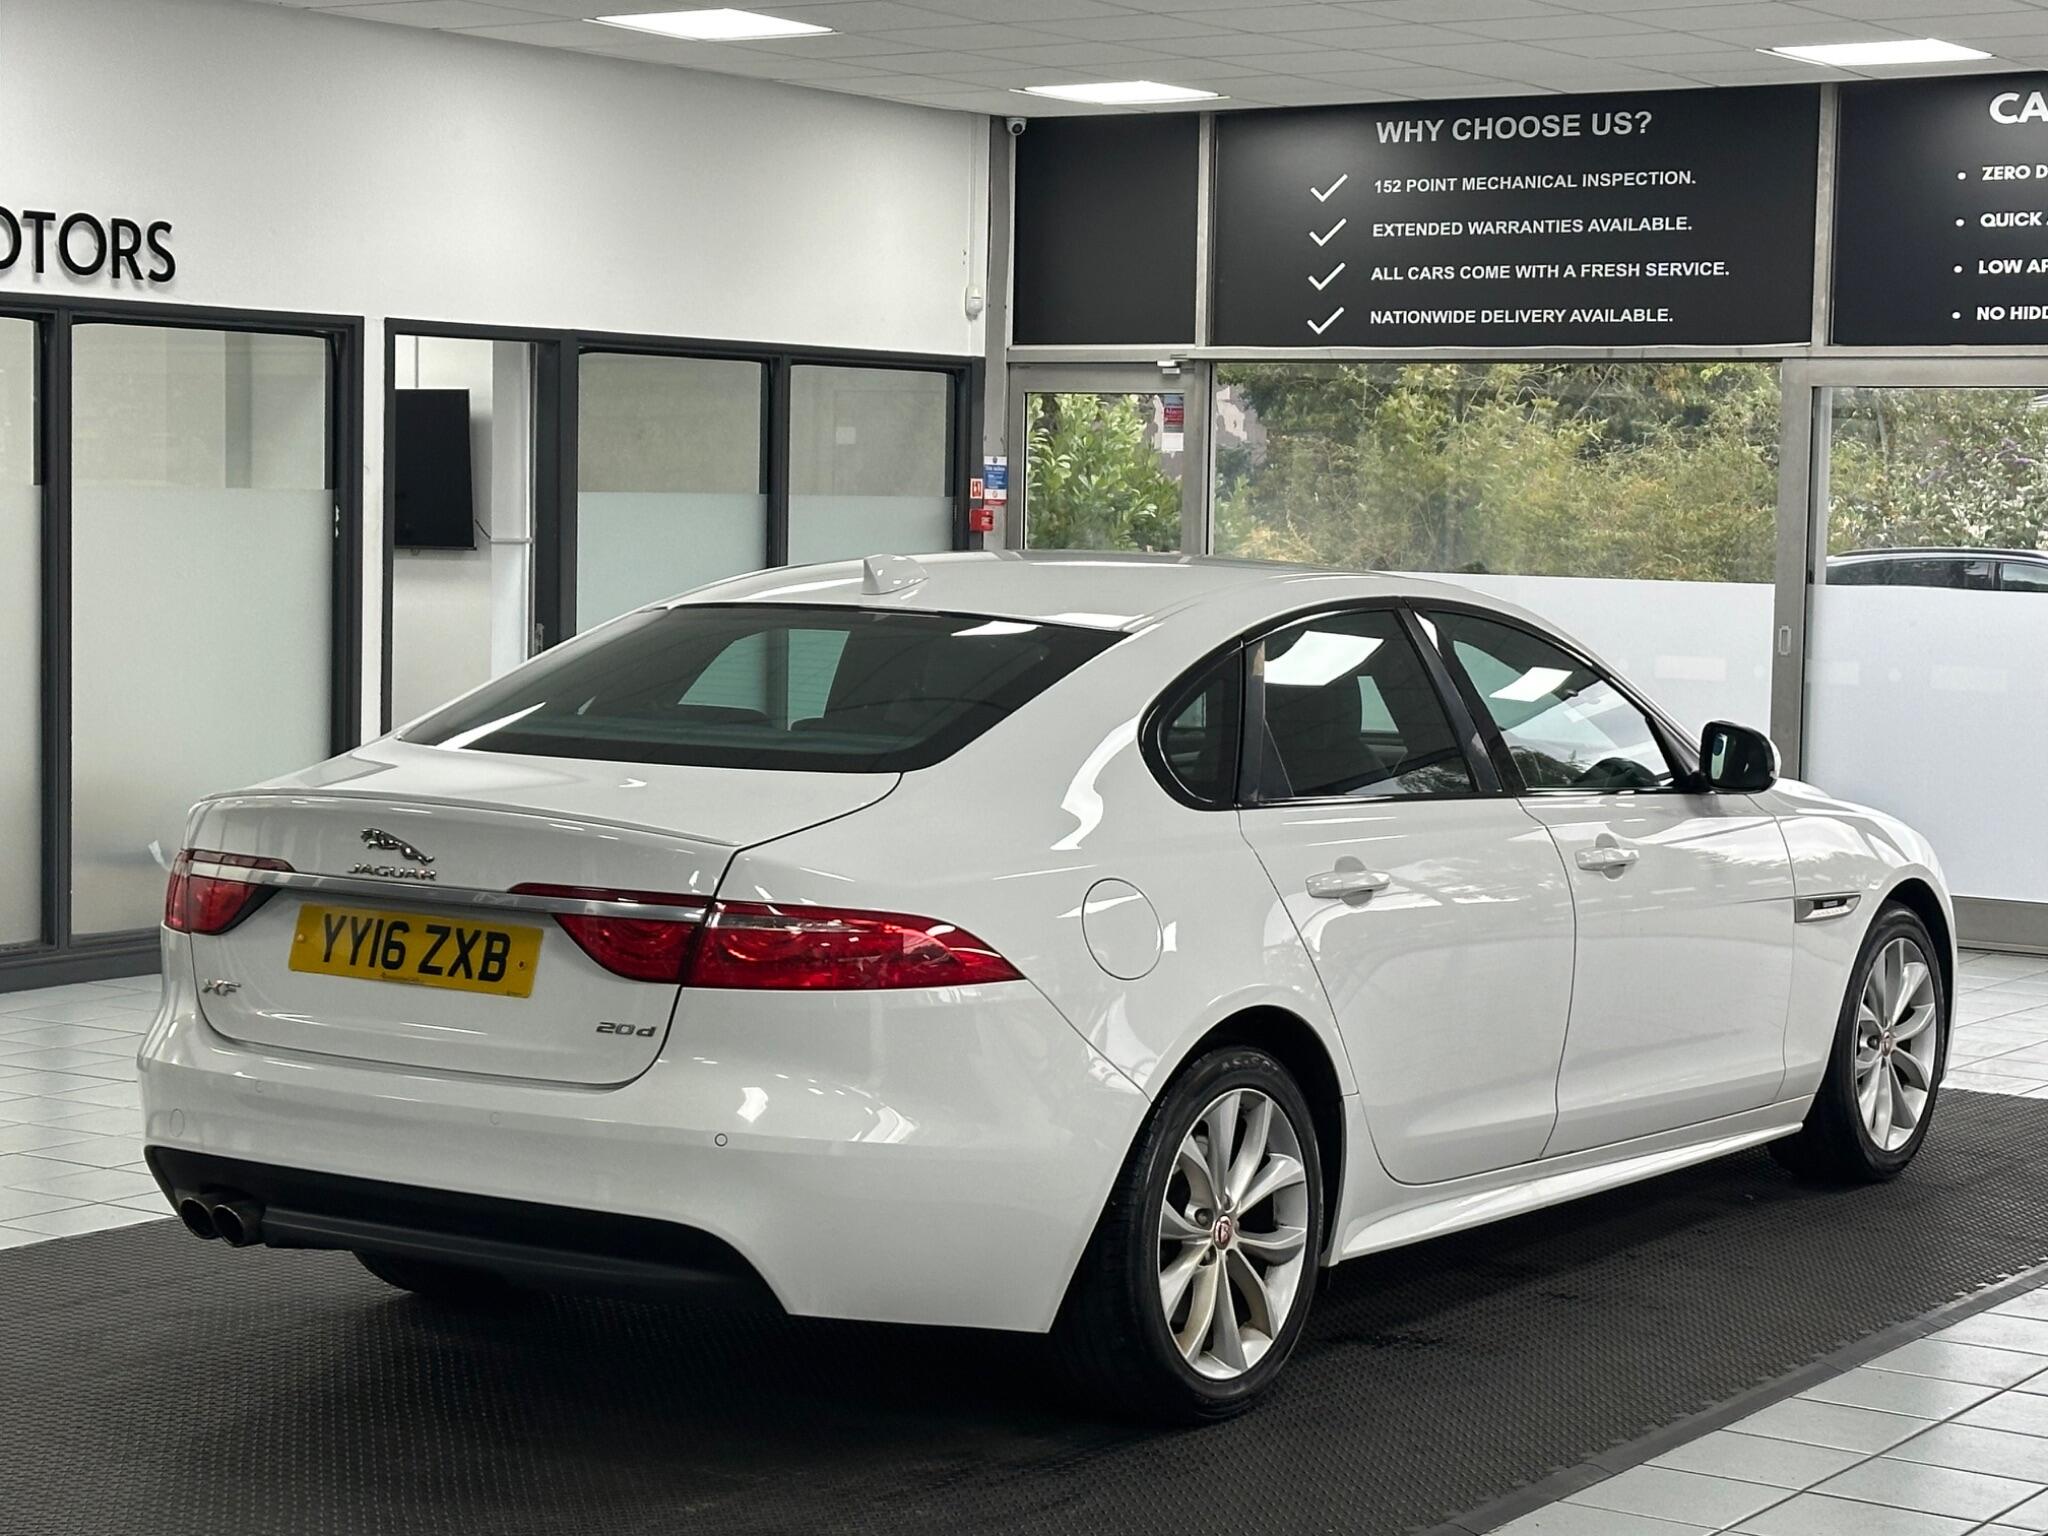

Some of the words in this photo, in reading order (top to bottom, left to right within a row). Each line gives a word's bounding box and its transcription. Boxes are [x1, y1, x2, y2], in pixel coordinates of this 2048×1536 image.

[1989, 91, 2048, 124] CA
[1376, 119, 1445, 144] WHY
[1452, 115, 1581, 141] CHOOSE
[1591, 111, 1653, 136] US?
[1981, 164, 2031, 181] ZERO
[2035, 163, 2048, 180] D
[1374, 179, 1402, 194] 152
[1406, 178, 1458, 193] POINT
[1461, 175, 1578, 191] MECHANICAL
[1582, 170, 1697, 188] INSPECTION.
[1372, 221, 1464, 238] EXTENDED
[1467, 219, 1584, 236] WARRANTIES
[1587, 216, 1693, 233] AVAILABLE.
[1980, 212, 2043, 228] QUICK
[1370, 267, 1404, 281] ALL
[1407, 266, 1455, 281] CARS
[1459, 265, 1511, 280] COME
[1514, 265, 1560, 279] WITH
[1562, 264, 1577, 279] A
[1580, 263, 1641, 278] FRESH
[1645, 261, 1730, 277] SERVICE.
[1978, 259, 2023, 275] LOW
[1370, 310, 1477, 325] NATIONWIDE
[1481, 309, 1568, 324] DELIVERY
[1569, 308, 1674, 324] AVAILABLE.
[1976, 306, 2006, 322] NO
[347, 862, 437, 882] JAGUAR
[323, 912, 410, 971] YY16
[417, 925, 511, 982] ZXB
[201, 978, 242, 997] XF
[596, 1021, 657, 1038] 20d
